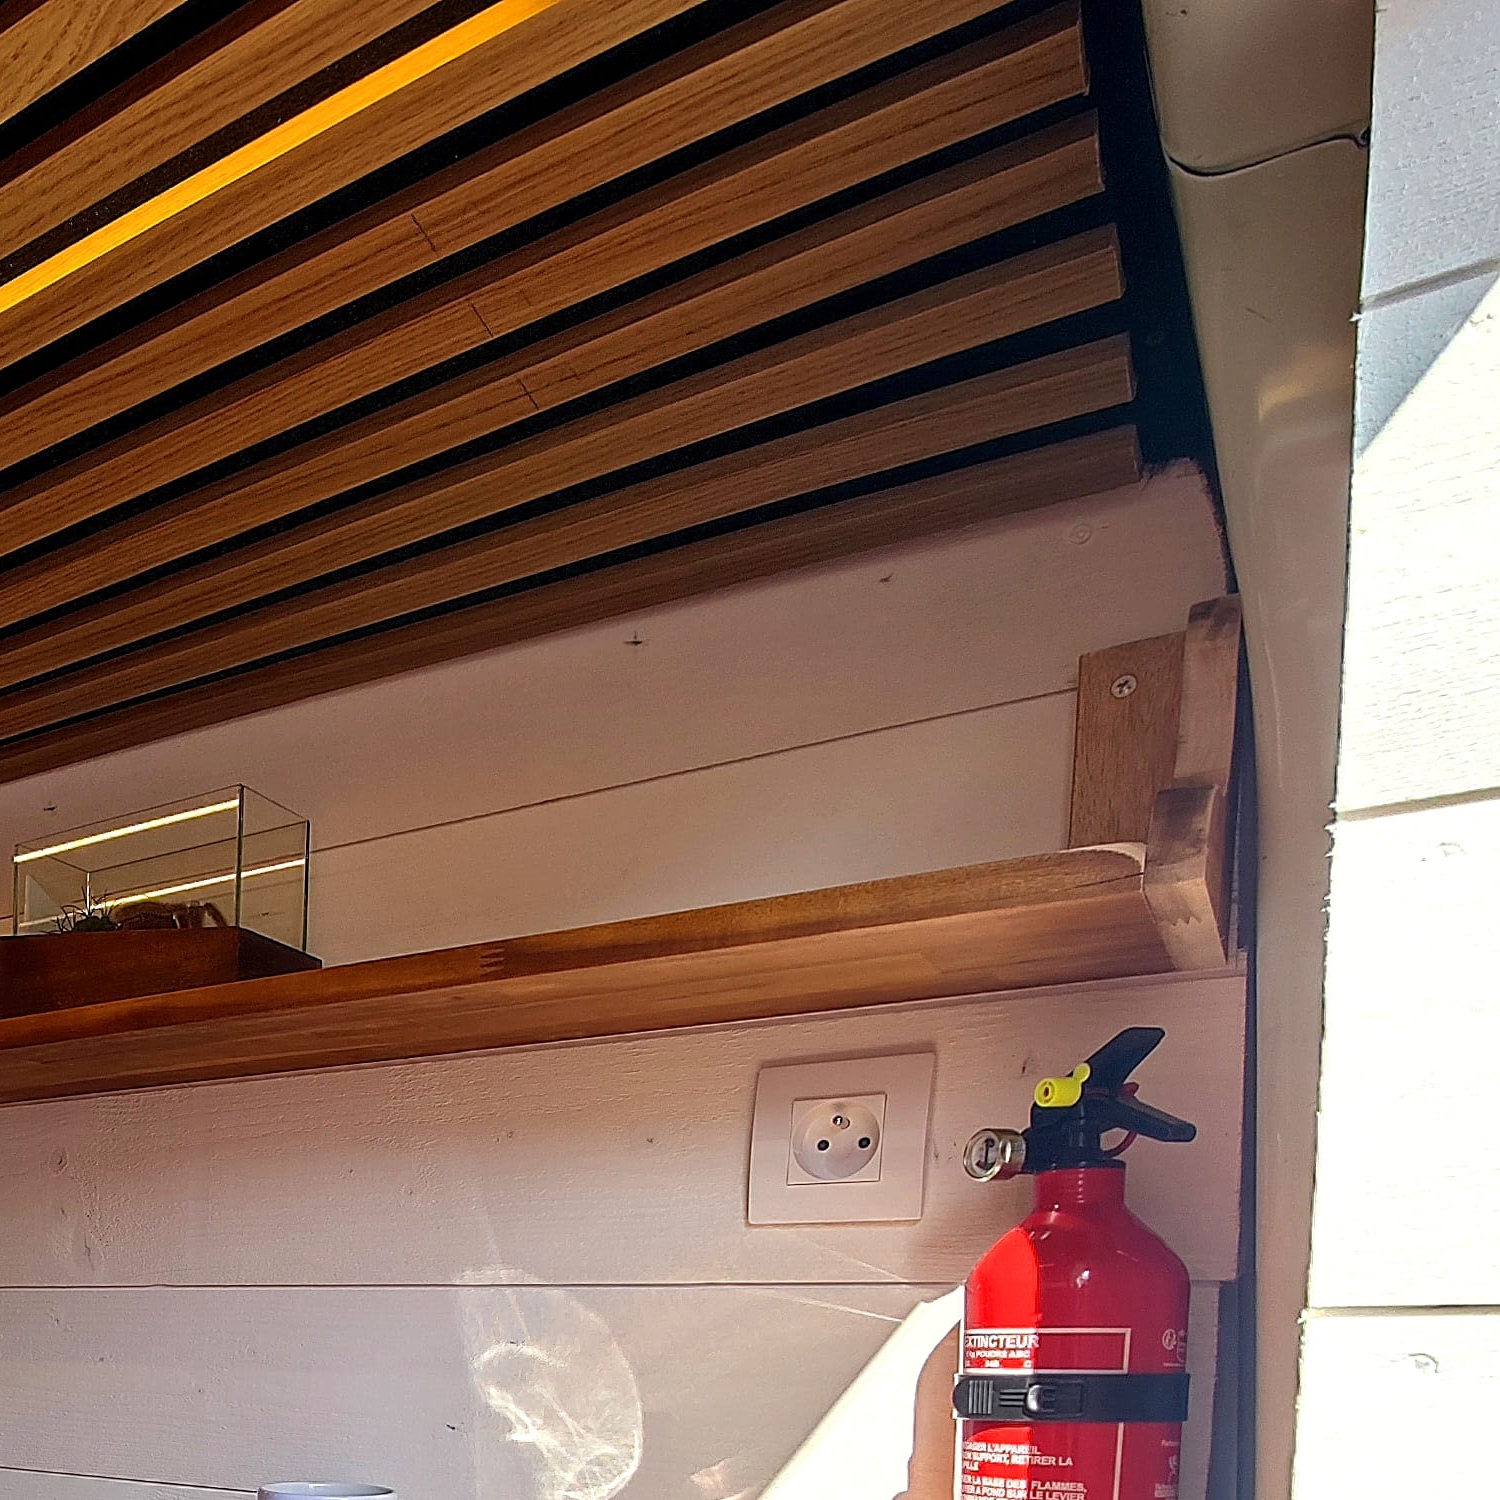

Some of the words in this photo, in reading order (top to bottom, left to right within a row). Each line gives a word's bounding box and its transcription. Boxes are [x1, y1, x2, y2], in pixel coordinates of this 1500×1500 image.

[1011, 1454, 1056, 1466] RETIRER
[1058, 1457, 1074, 1466] LA
[1031, 1481, 1088, 1493] FLAMMES,
[982, 1487, 1006, 1498] FOND
[1030, 1491, 1044, 1500] LE
